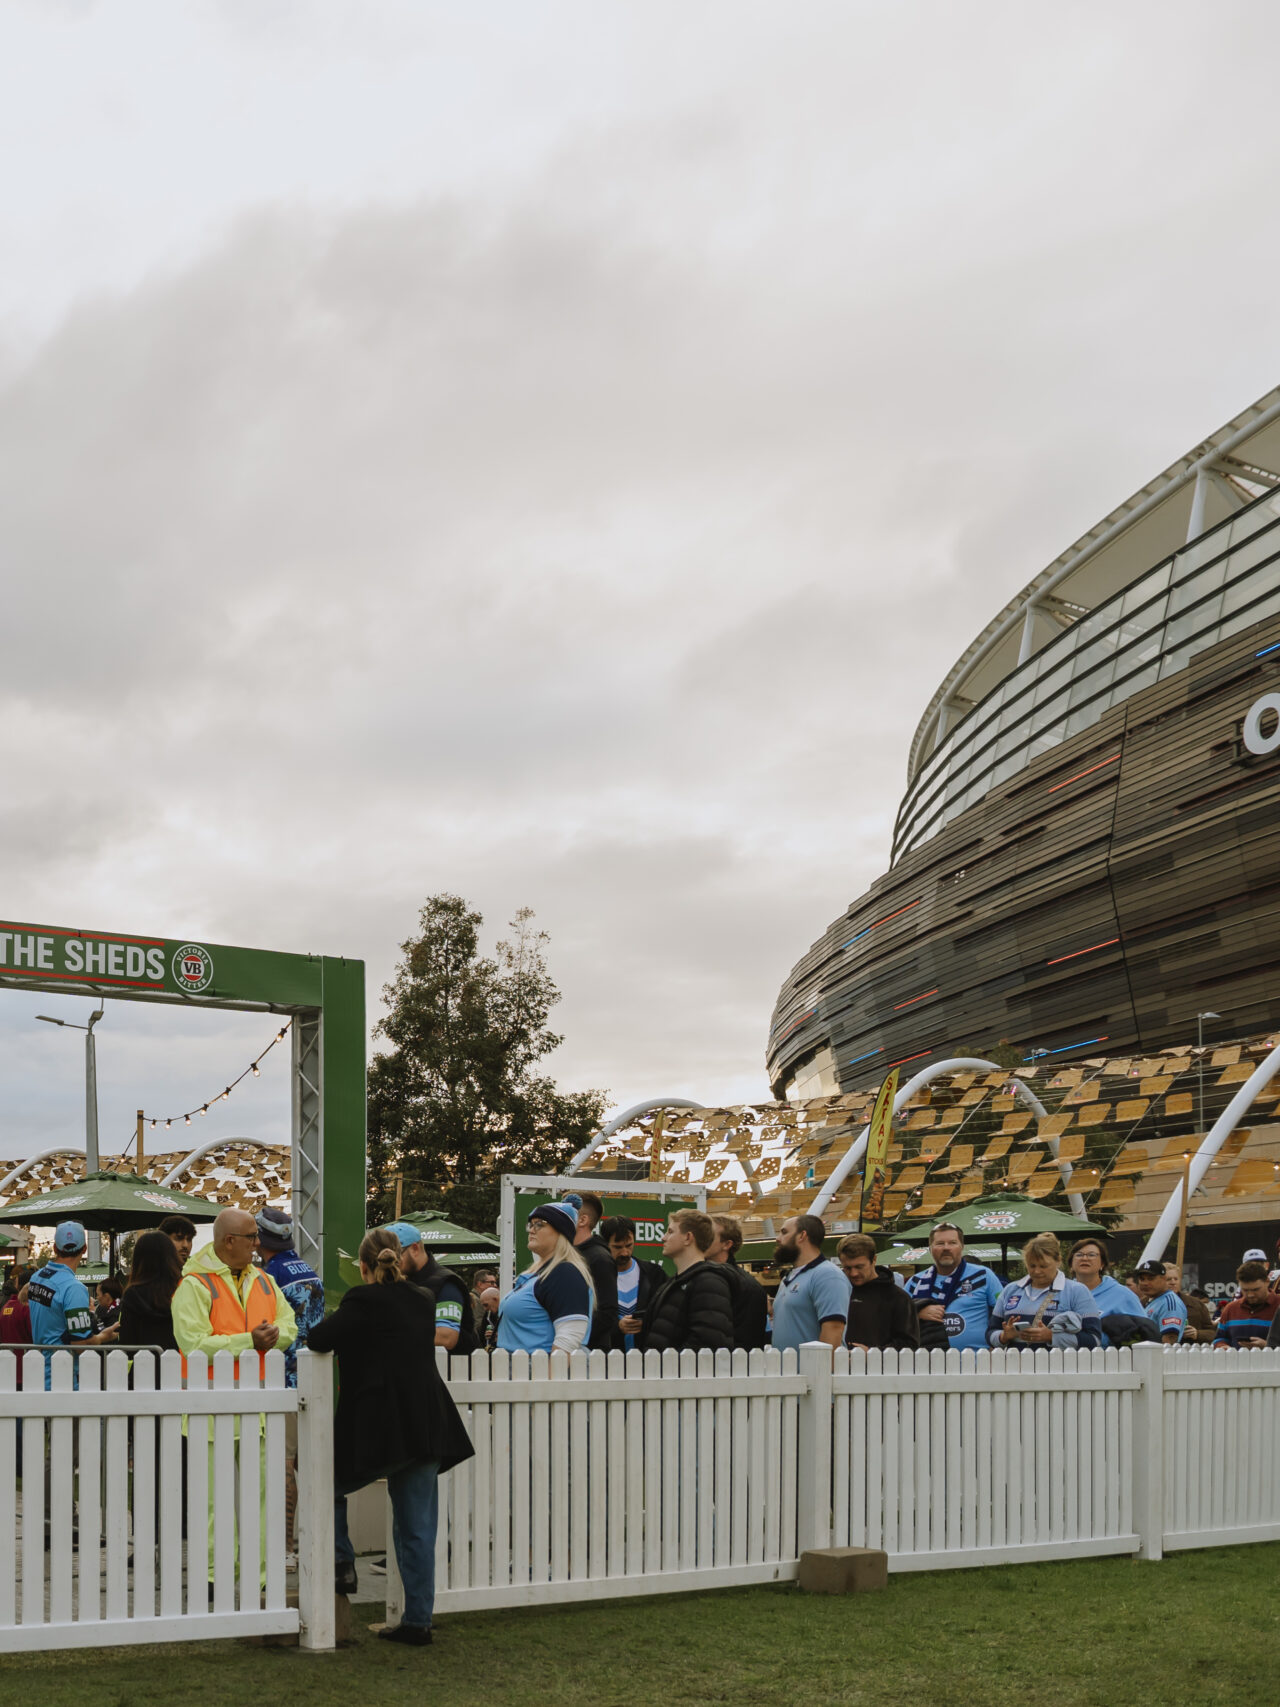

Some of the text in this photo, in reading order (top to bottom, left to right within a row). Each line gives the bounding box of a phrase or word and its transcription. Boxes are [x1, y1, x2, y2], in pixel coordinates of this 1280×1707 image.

[64, 939, 165, 981] SHEDS
[176, 947, 209, 964] VICTORIA
[183, 961, 202, 975] VB
[178, 976, 207, 989] BITTER
[877, 1076, 893, 1153] SATAY
[635, 1221, 665, 1242] EDS
[1204, 1281, 1238, 1298] SPO
[67, 1311, 91, 1330] nib
[435, 1304, 462, 1320] nib
